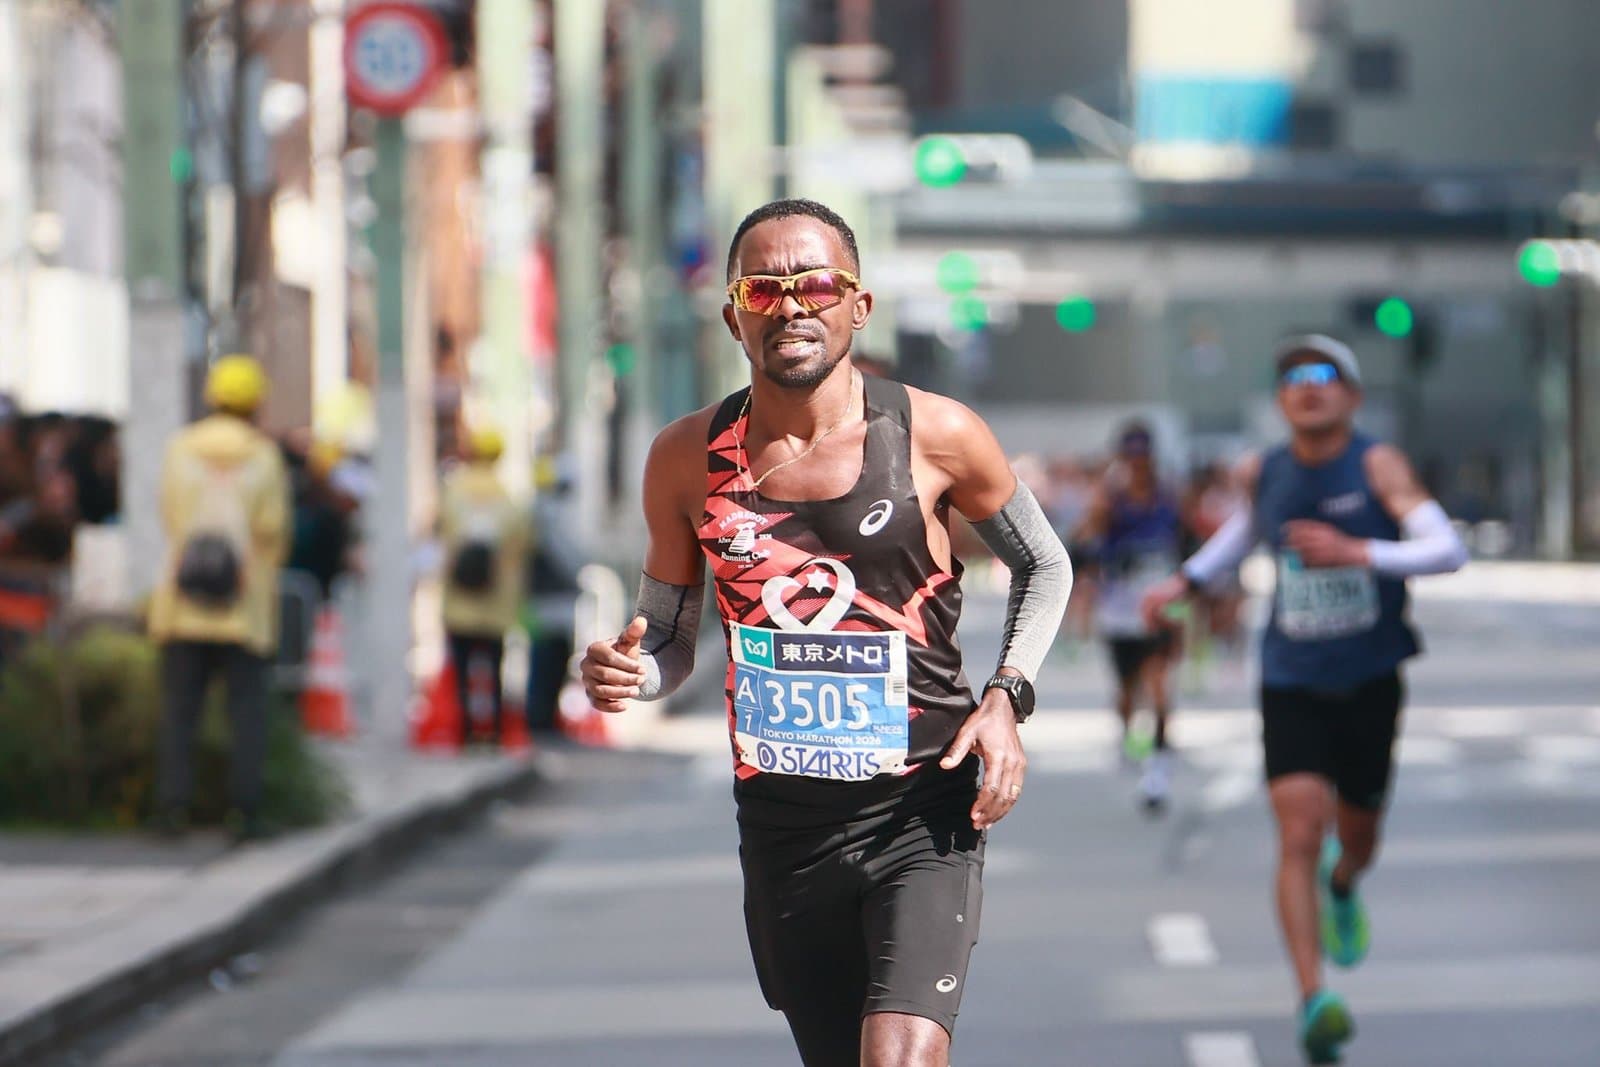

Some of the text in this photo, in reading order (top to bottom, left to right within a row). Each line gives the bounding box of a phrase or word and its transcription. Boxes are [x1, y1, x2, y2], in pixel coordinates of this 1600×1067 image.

[721, 551, 752, 563] Running
[781, 643, 883, 664] 東京メトロ
[737, 677, 756, 703] A
[764, 680, 871, 729] 3505
[744, 713, 752, 732] 1
[763, 727, 881, 745] TOKYO MARATHON 2026
